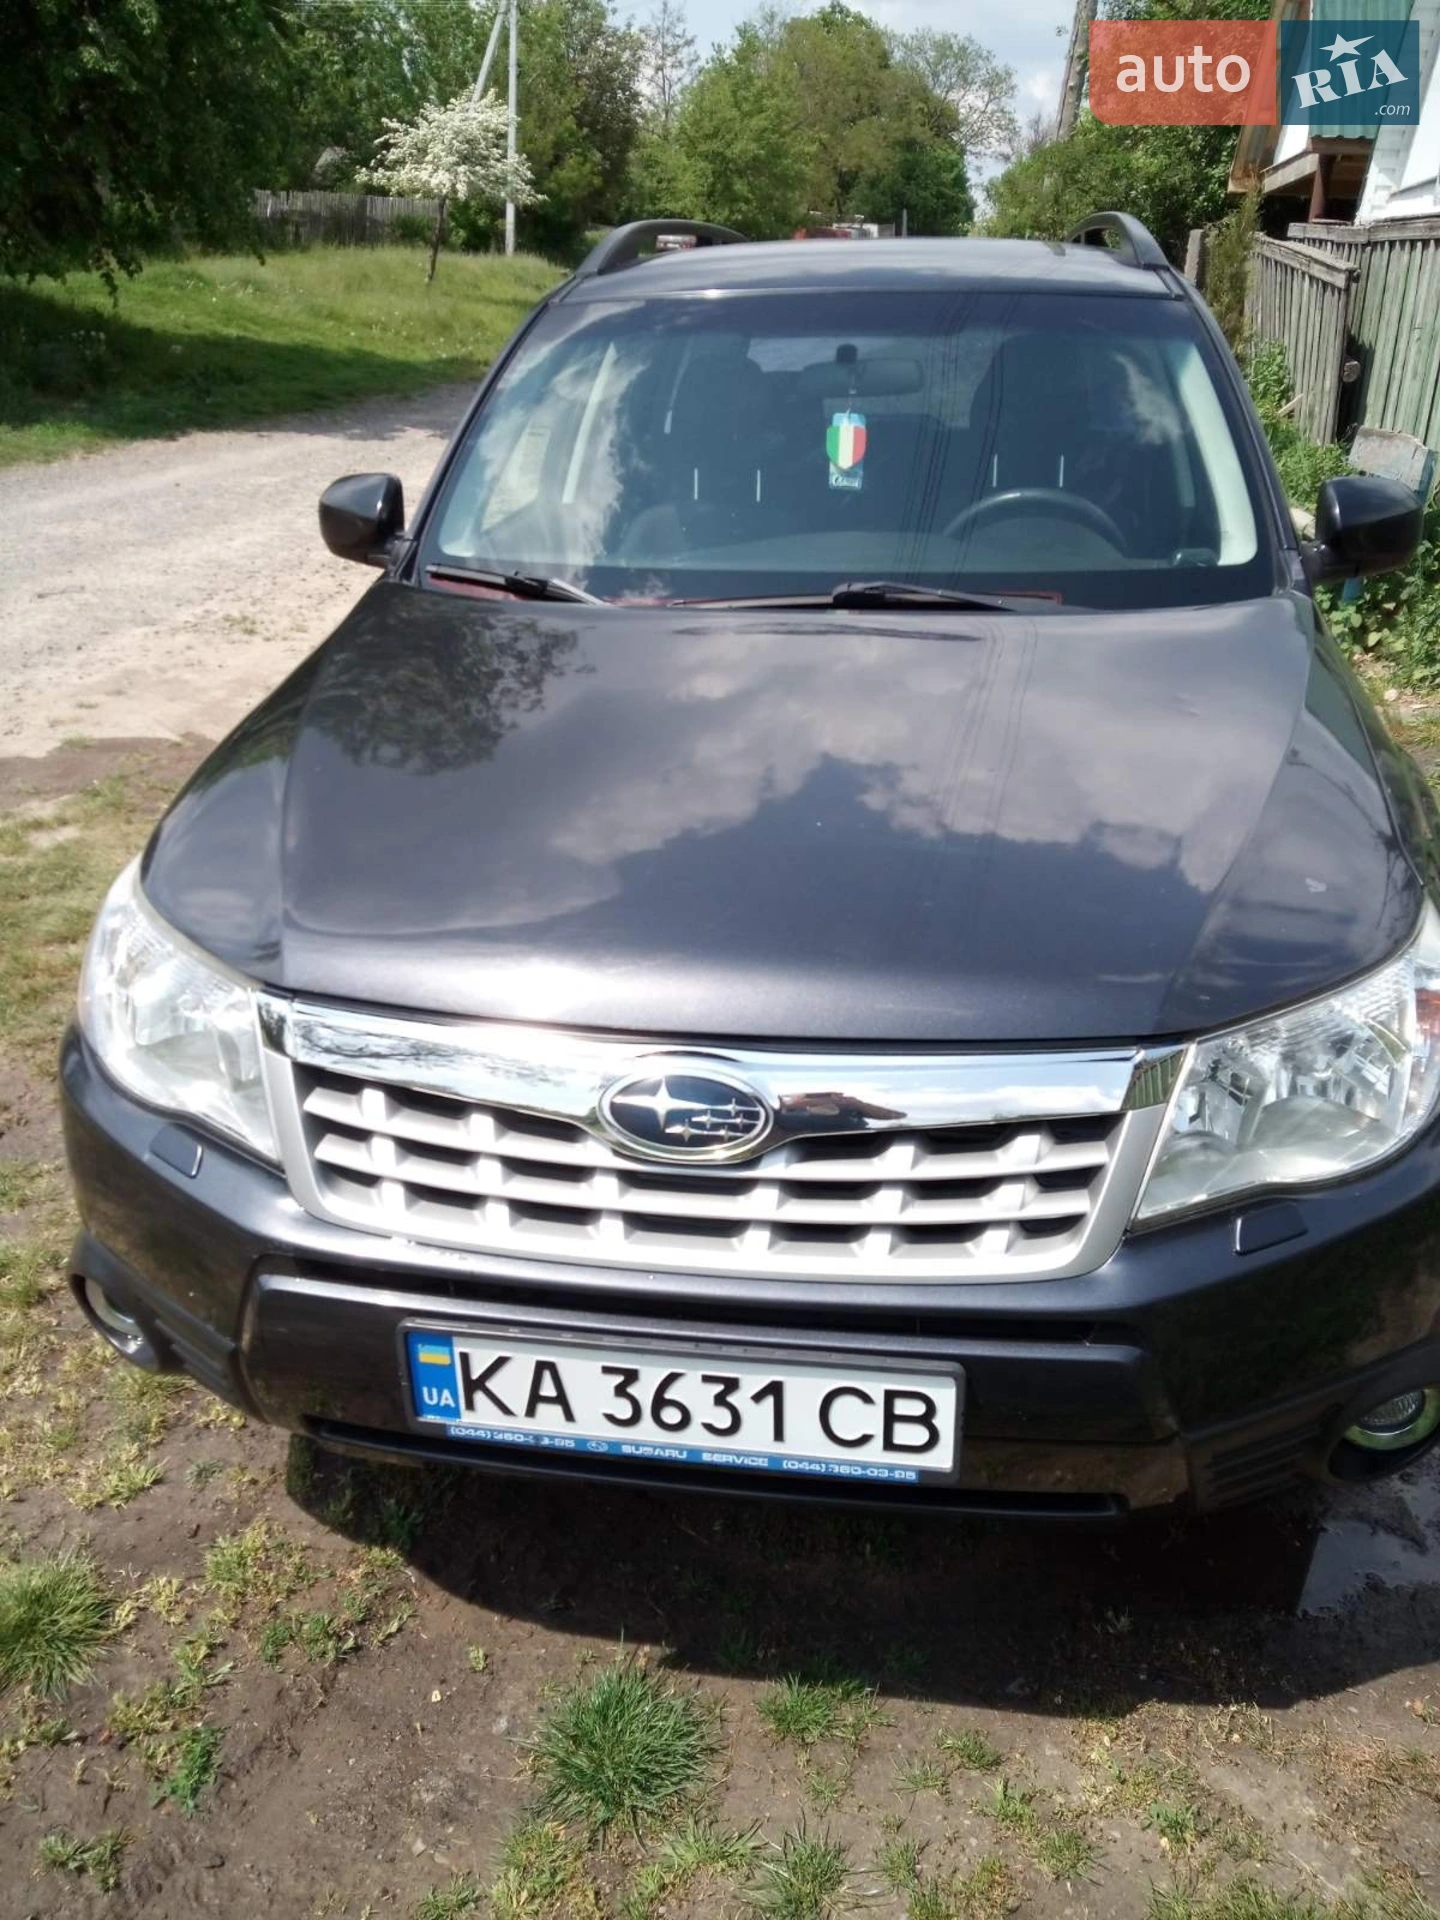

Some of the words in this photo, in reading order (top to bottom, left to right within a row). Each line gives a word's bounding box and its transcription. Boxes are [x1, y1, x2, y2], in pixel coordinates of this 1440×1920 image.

[422, 1386, 456, 1408] UA
[458, 1351, 577, 1423] KA
[601, 1365, 785, 1442] 3631
[819, 1386, 940, 1454] CB
[621, 1444, 688, 1459] SUBARU
[702, 1452, 769, 1467] SERVICE
